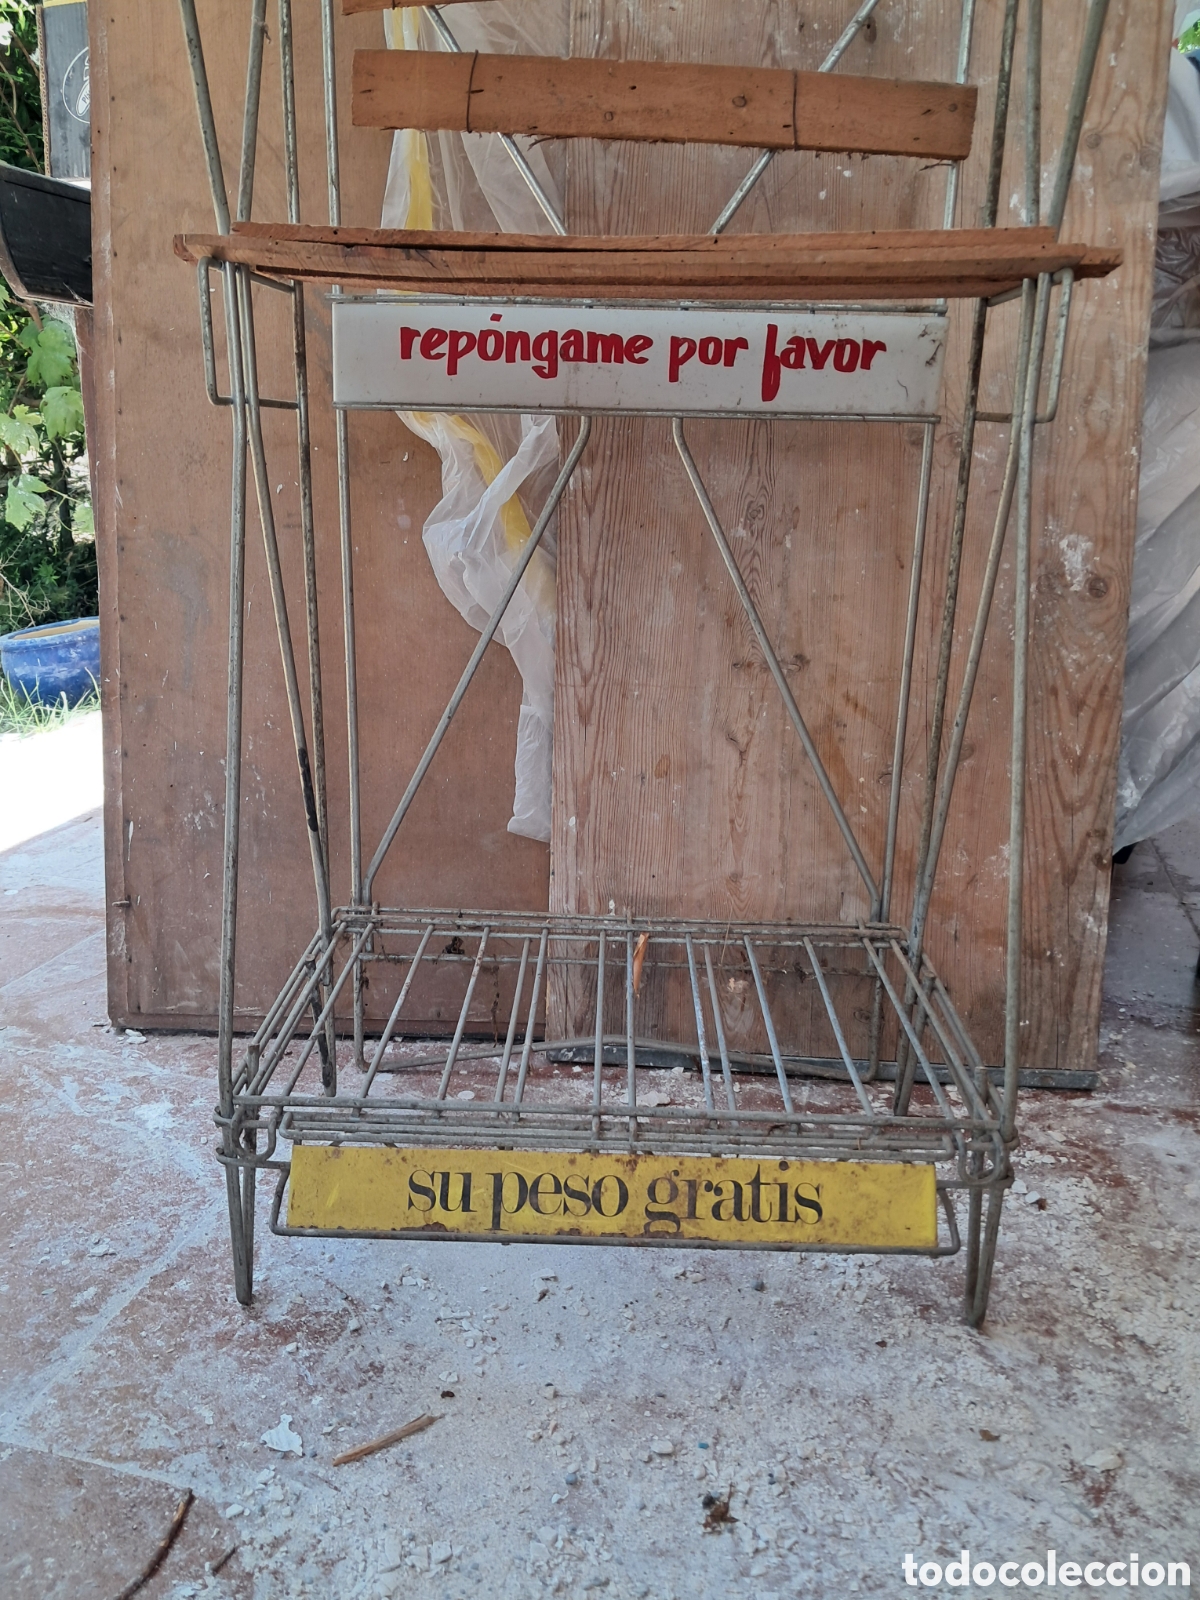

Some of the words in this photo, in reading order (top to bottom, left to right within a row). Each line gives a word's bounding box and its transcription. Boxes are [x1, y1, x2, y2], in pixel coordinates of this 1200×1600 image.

[400, 313, 654, 379] repóngame
[668, 336, 749, 383] por
[761, 323, 887, 402] favor
[407, 1169, 478, 1213] su
[484, 1171, 630, 1231] peso
[643, 1160, 824, 1236] gratis
